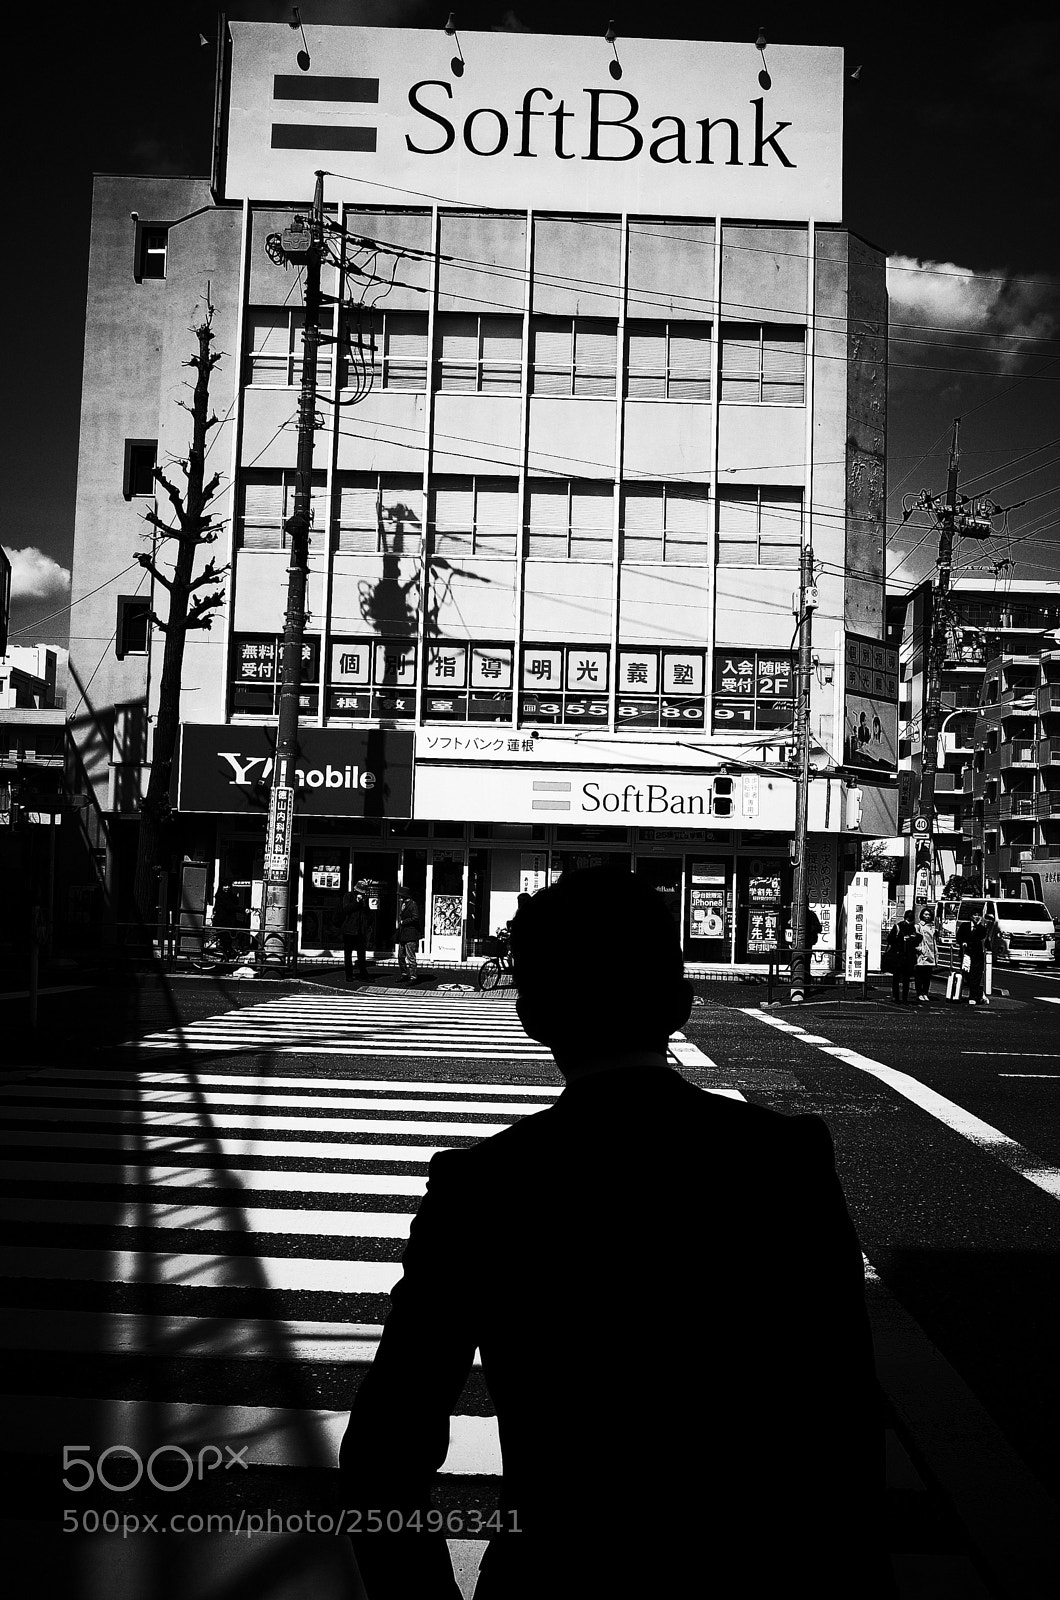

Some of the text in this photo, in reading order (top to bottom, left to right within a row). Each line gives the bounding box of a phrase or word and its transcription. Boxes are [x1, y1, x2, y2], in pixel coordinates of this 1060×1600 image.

[405, 80, 797, 169] SoftBank
[721, 659, 791, 676] 入会随時
[539, 702, 752, 721] 3558-8091
[427, 736, 535, 752] ソフトバンク蓮根
[916, 820, 926, 829] 40
[751, 928, 776, 941] 先生
